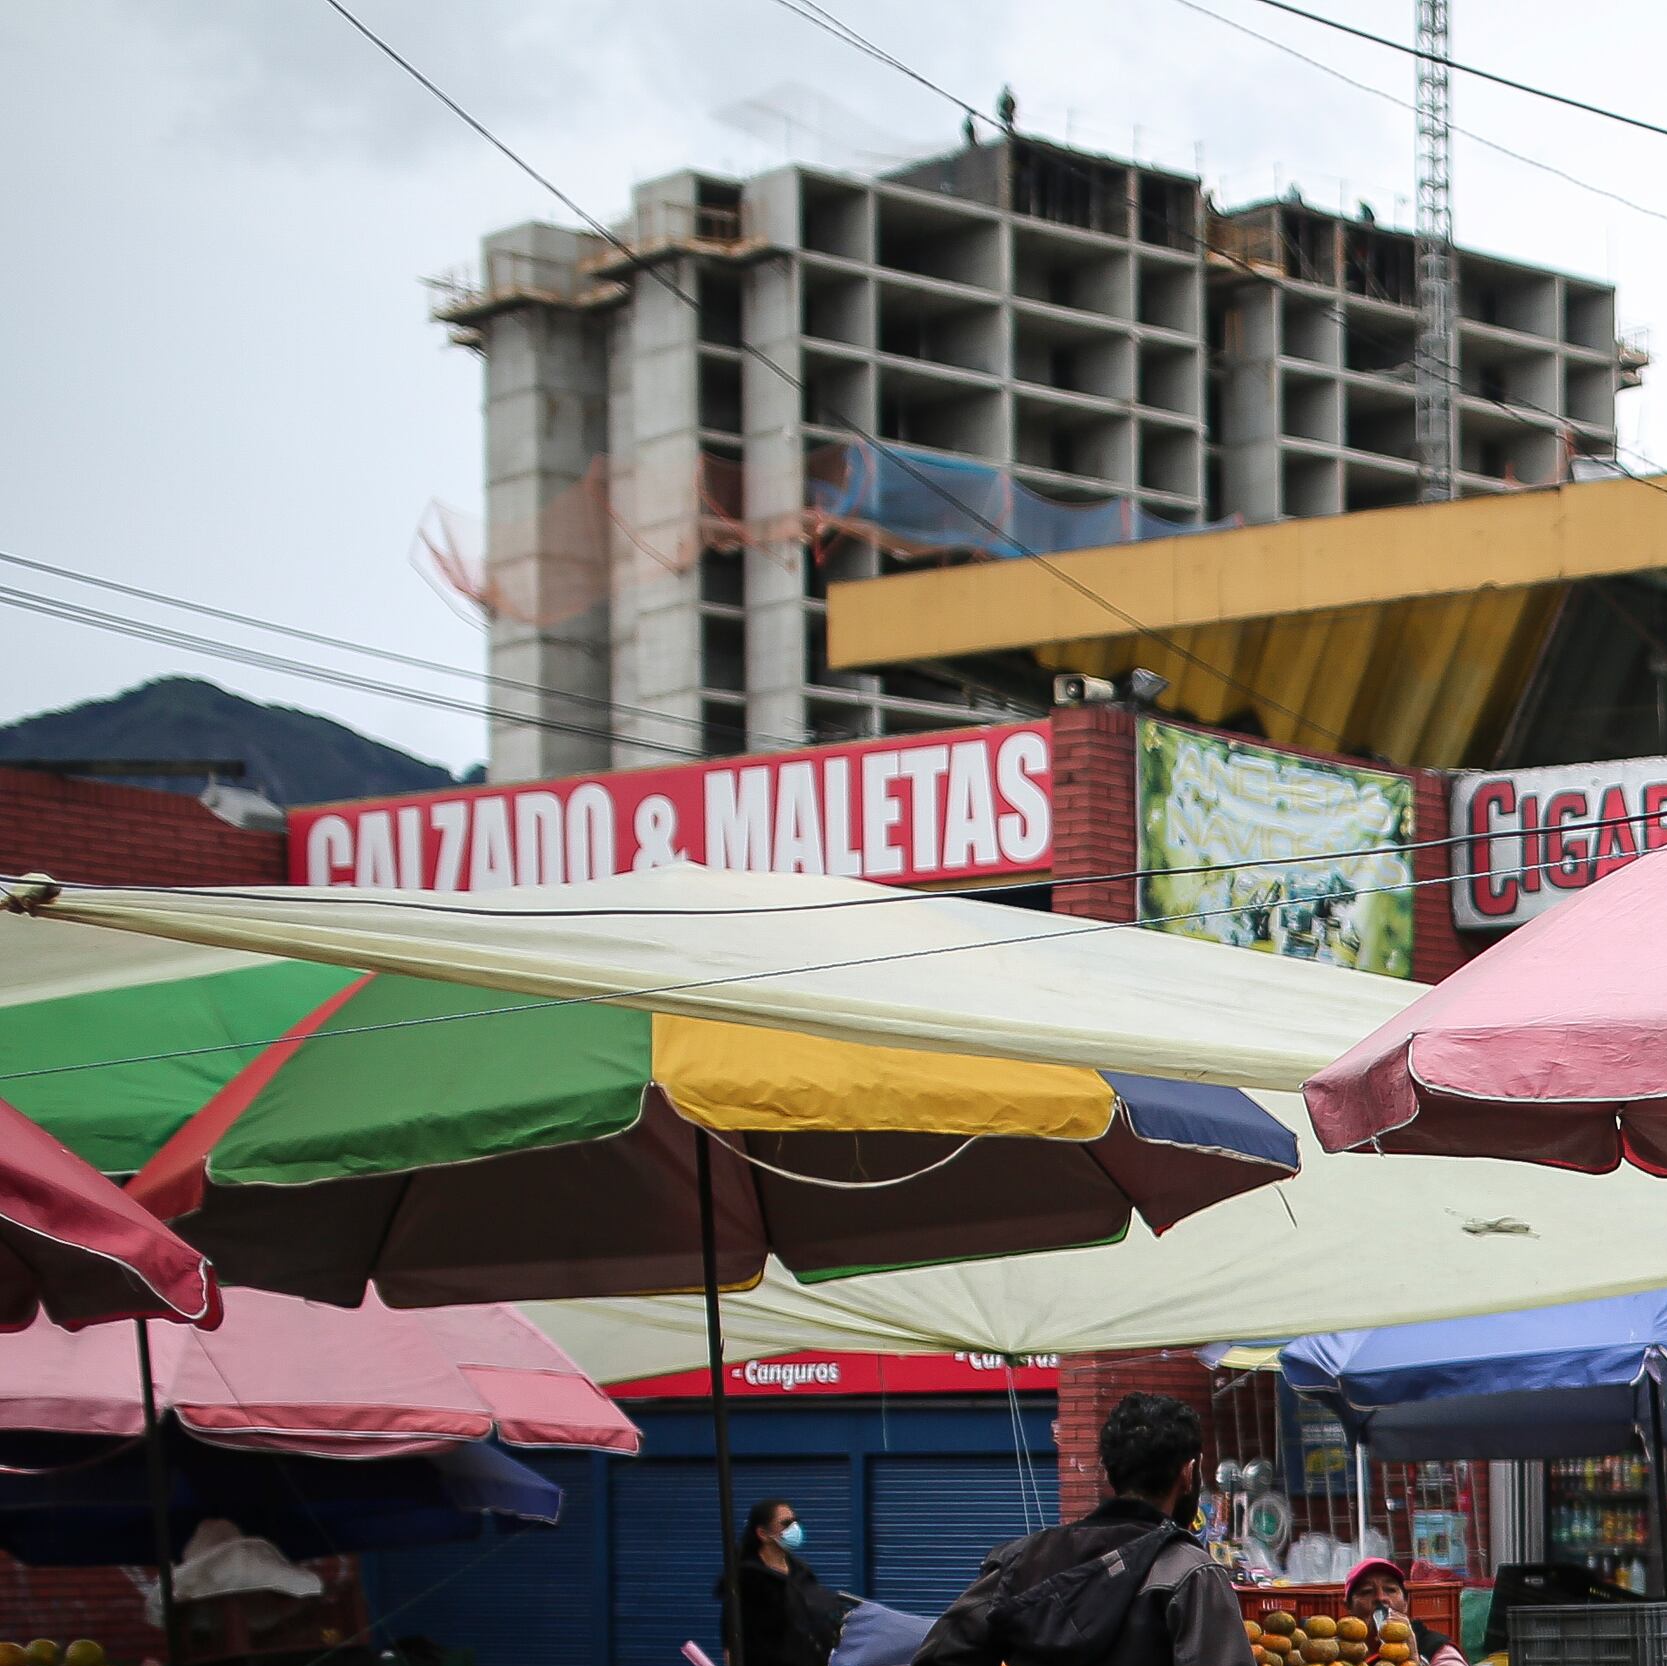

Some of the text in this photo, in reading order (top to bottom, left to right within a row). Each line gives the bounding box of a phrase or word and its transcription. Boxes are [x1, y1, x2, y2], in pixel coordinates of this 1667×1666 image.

[307, 782, 614, 891] CALZADO
[703, 730, 1051, 877] MALETAS
[744, 1360, 840, 1391] Canguros
